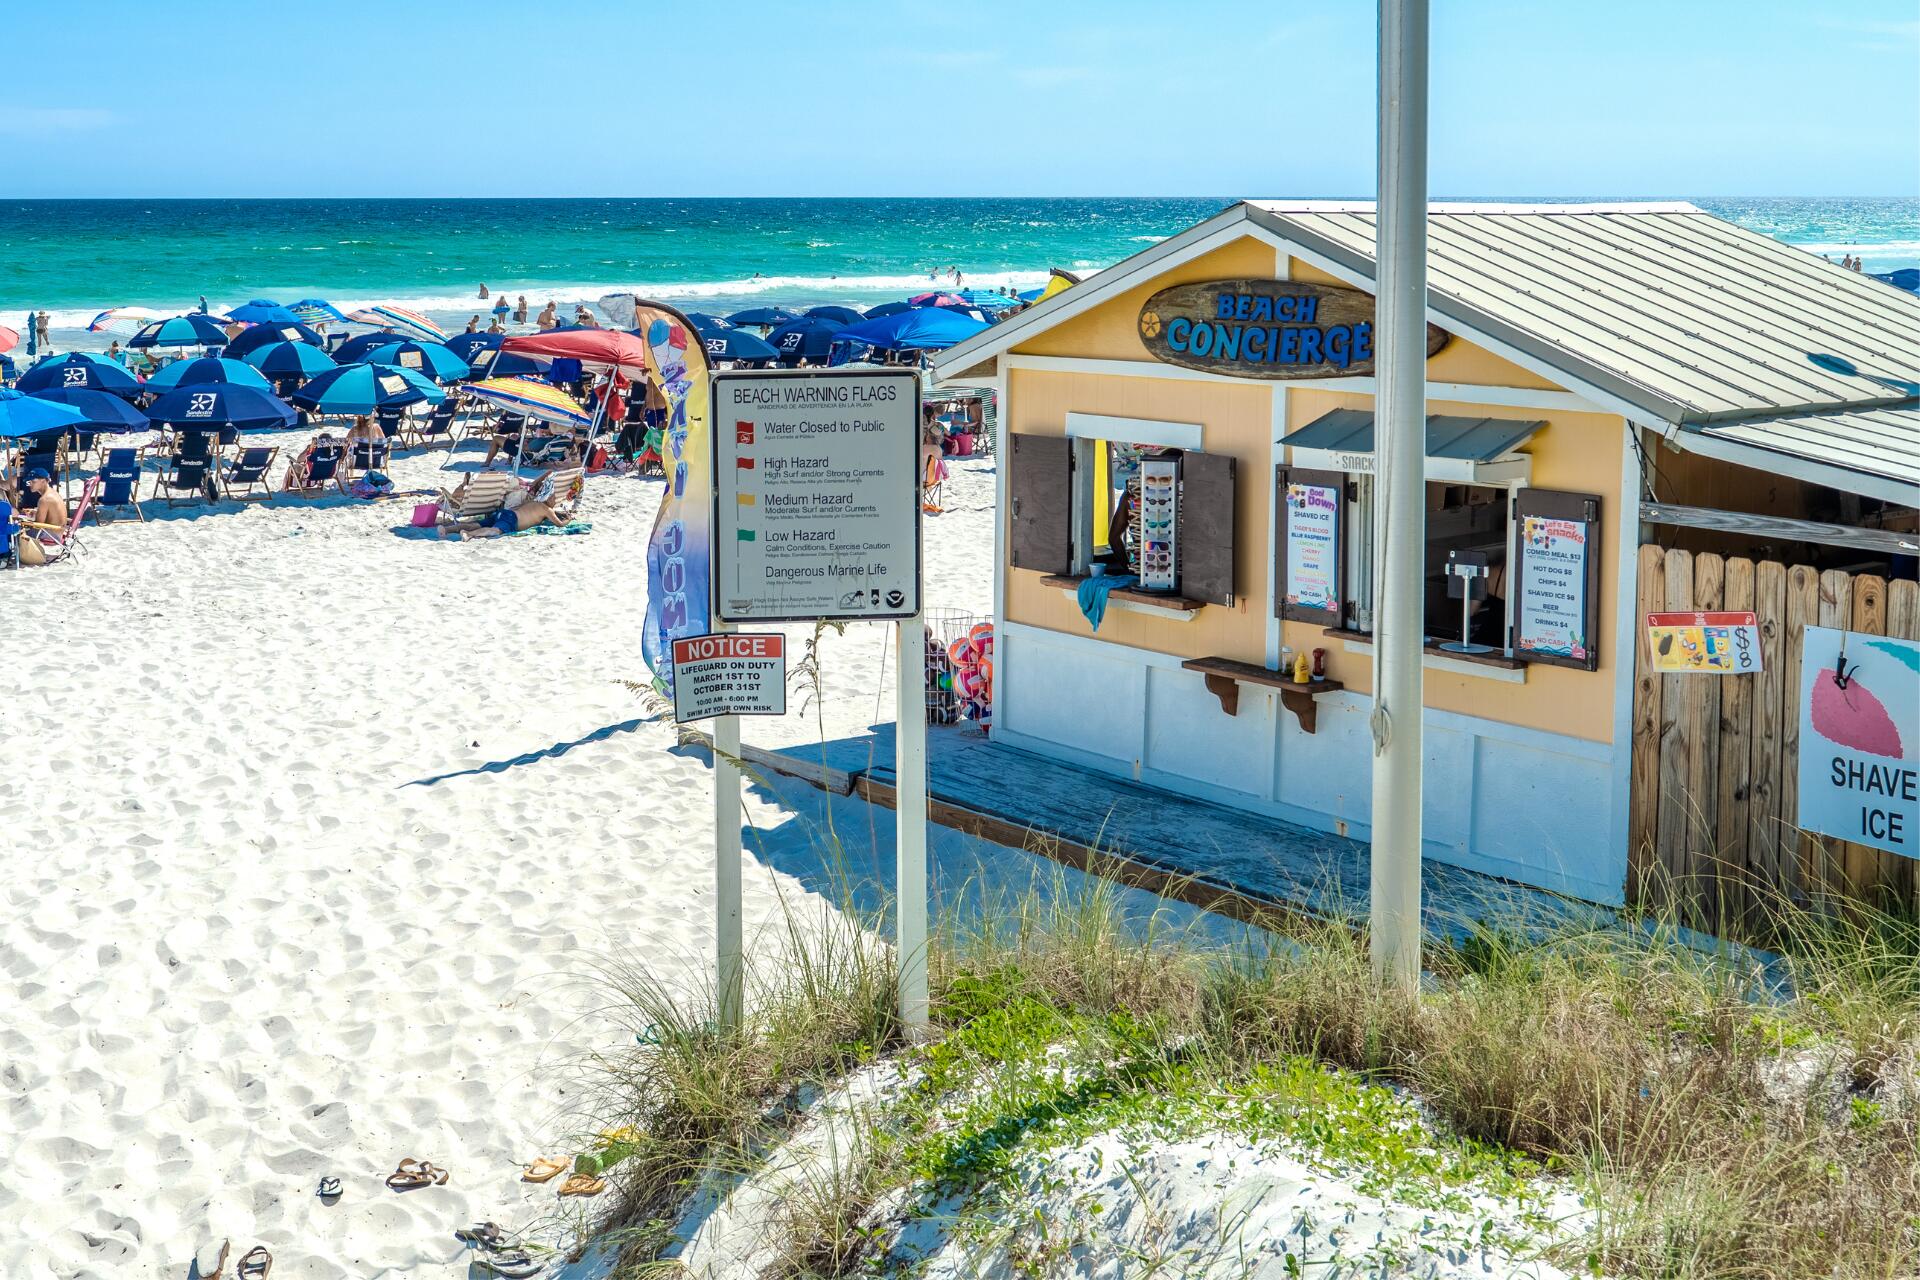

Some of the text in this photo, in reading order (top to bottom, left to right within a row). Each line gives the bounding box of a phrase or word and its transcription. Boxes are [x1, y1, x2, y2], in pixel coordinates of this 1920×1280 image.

[1216, 294, 1319, 323] BEACH
[1167, 317, 1372, 368] CONCIERGE
[734, 386, 896, 404] BEACH WARNING FLAGS
[765, 420, 884, 433] Water Closed to Public
[765, 456, 829, 471] High Hazard
[765, 471, 781, 480] High
[826, 470, 850, 478] Strong
[765, 493, 853, 505] Medium Hazard
[1308, 496, 1335, 511] Down
[765, 529, 835, 542] Low Hazard
[787, 544, 826, 552] Conditions,
[829, 543, 860, 551] Exercise
[766, 564, 887, 579] Dangerous Marine Life
[1535, 618, 1558, 626] DRINKS
[688, 639, 766, 660] NOTICE
[1734, 626, 1752, 668] $8
[681, 662, 727, 675] LIFEGUARD
[694, 673, 722, 684] MARCH
[694, 684, 733, 695] OCTOBER
[1830, 756, 1917, 802] SHAVE
[1862, 806, 1904, 843] ICE
